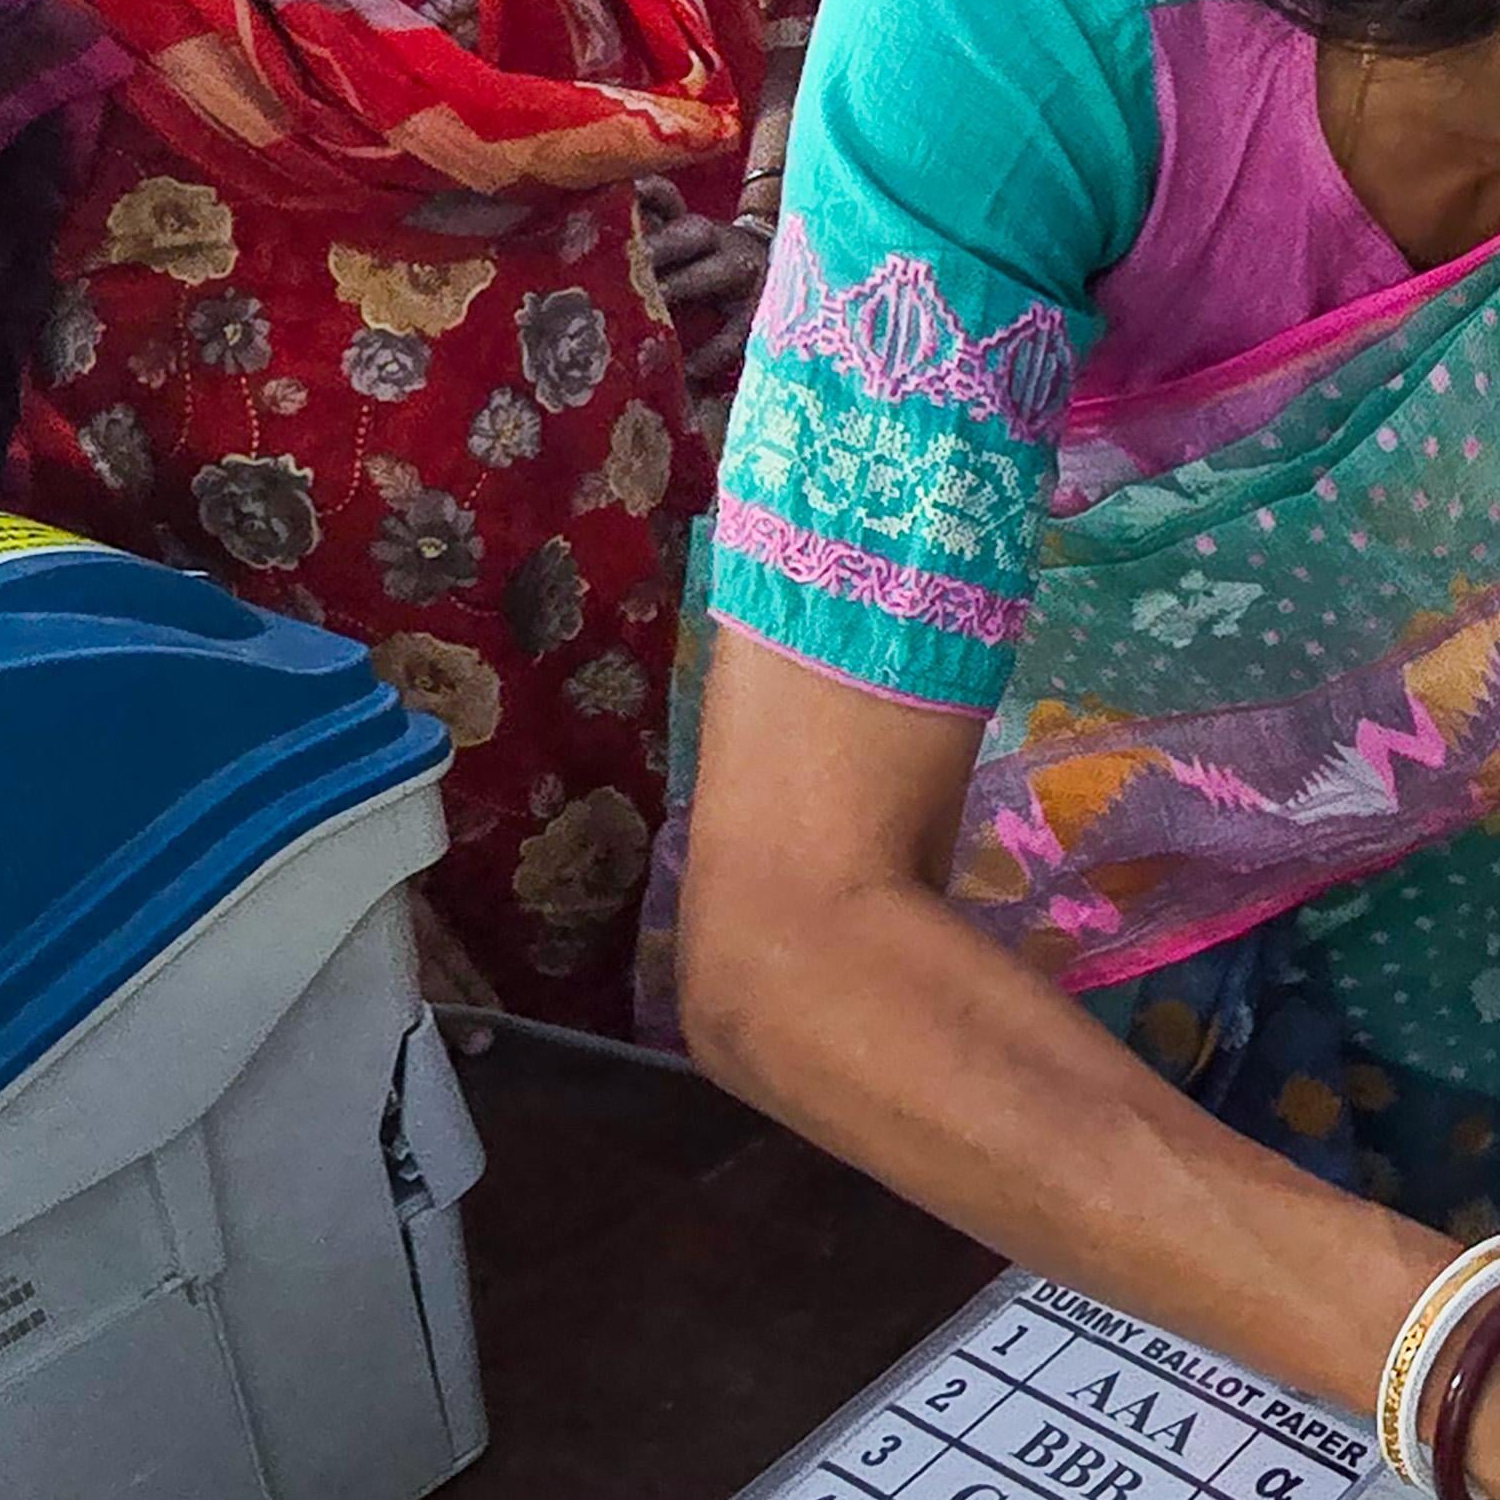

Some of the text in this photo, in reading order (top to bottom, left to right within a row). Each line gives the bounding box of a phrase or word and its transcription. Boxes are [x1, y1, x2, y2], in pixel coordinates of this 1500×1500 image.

[925, 1379, 967, 1412] 2
[992, 1325, 1028, 1356] 1
[1069, 1368, 1193, 1457] AAA
[1032, 1281, 1367, 1468] DUMMY BALLOT PAPER
[861, 1435, 902, 1466] 3
